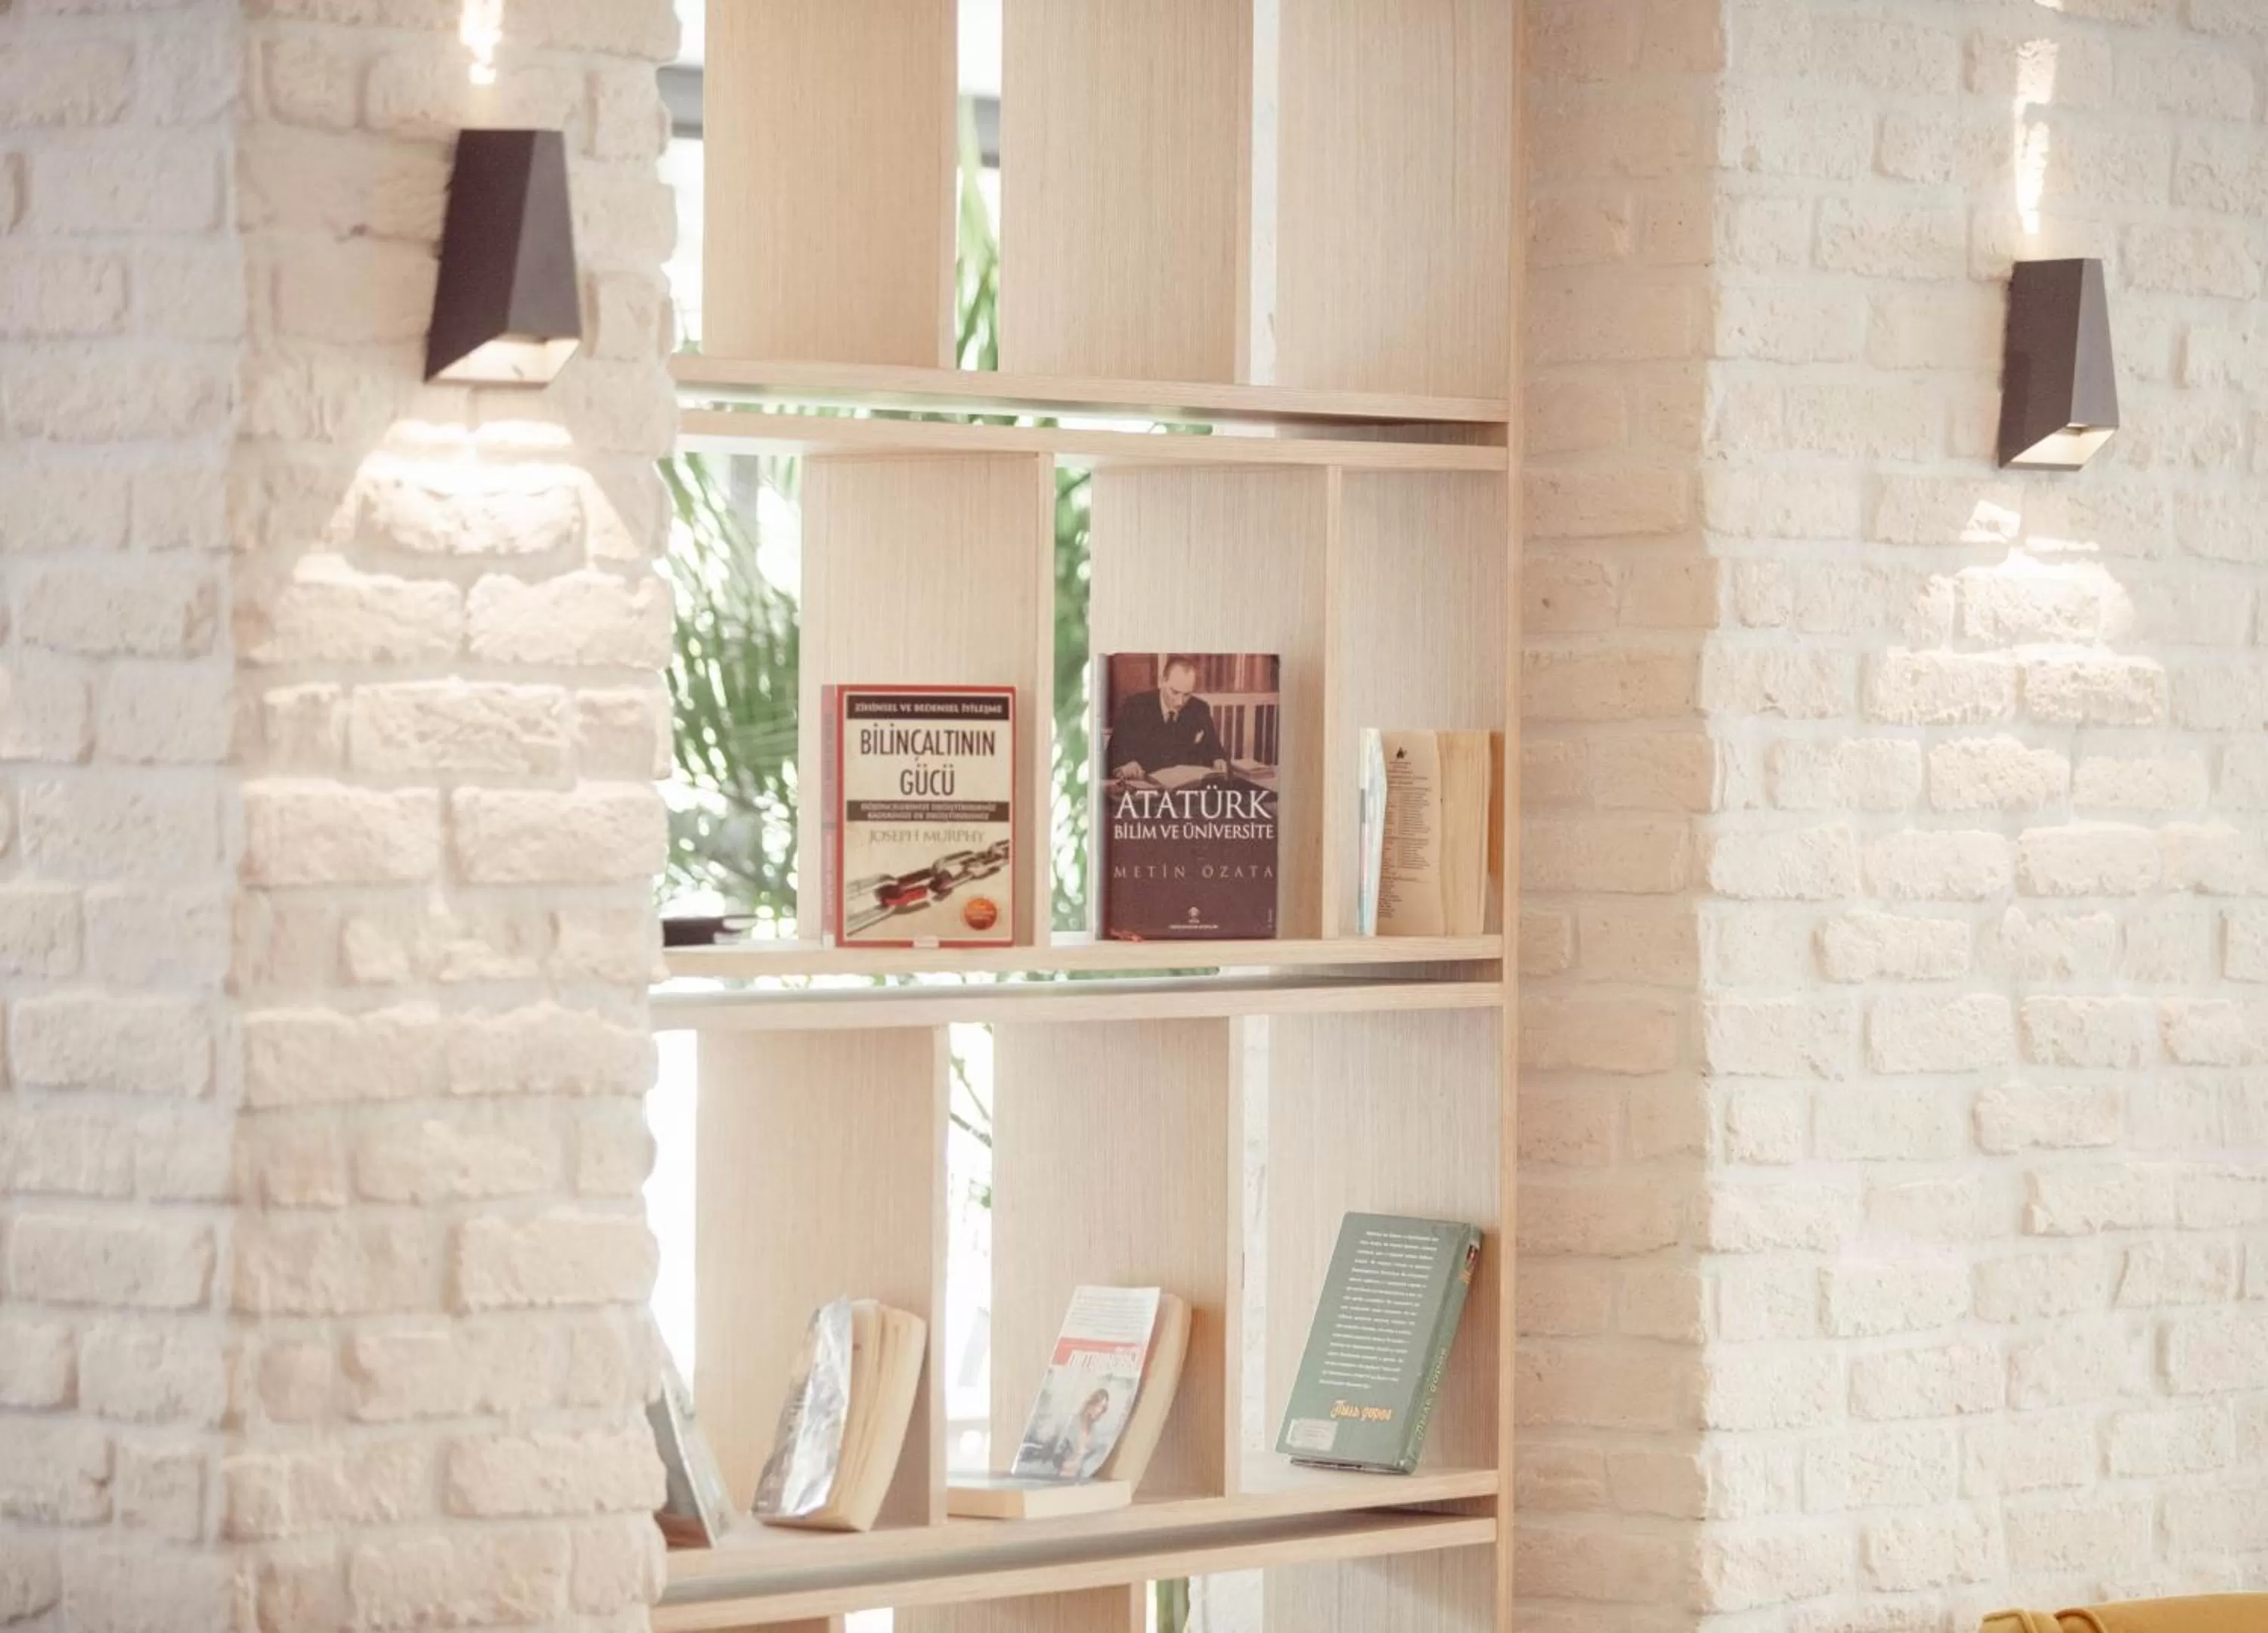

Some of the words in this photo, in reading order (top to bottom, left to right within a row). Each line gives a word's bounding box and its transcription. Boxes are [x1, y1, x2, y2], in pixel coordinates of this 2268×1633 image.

[900, 703, 912, 713] VE
[860, 722, 996, 761] BİLİNÇALTININ
[900, 763, 955, 795] GÜCÜ
[1114, 785, 1272, 819] ATATÜRK
[869, 829, 919, 843] JOSEPH
[922, 829, 986, 843] MURPHY
[1114, 823, 1157, 839] BİLİM
[1160, 825, 1181, 839] VE
[1183, 822, 1275, 839] ÜNİVERSİTE
